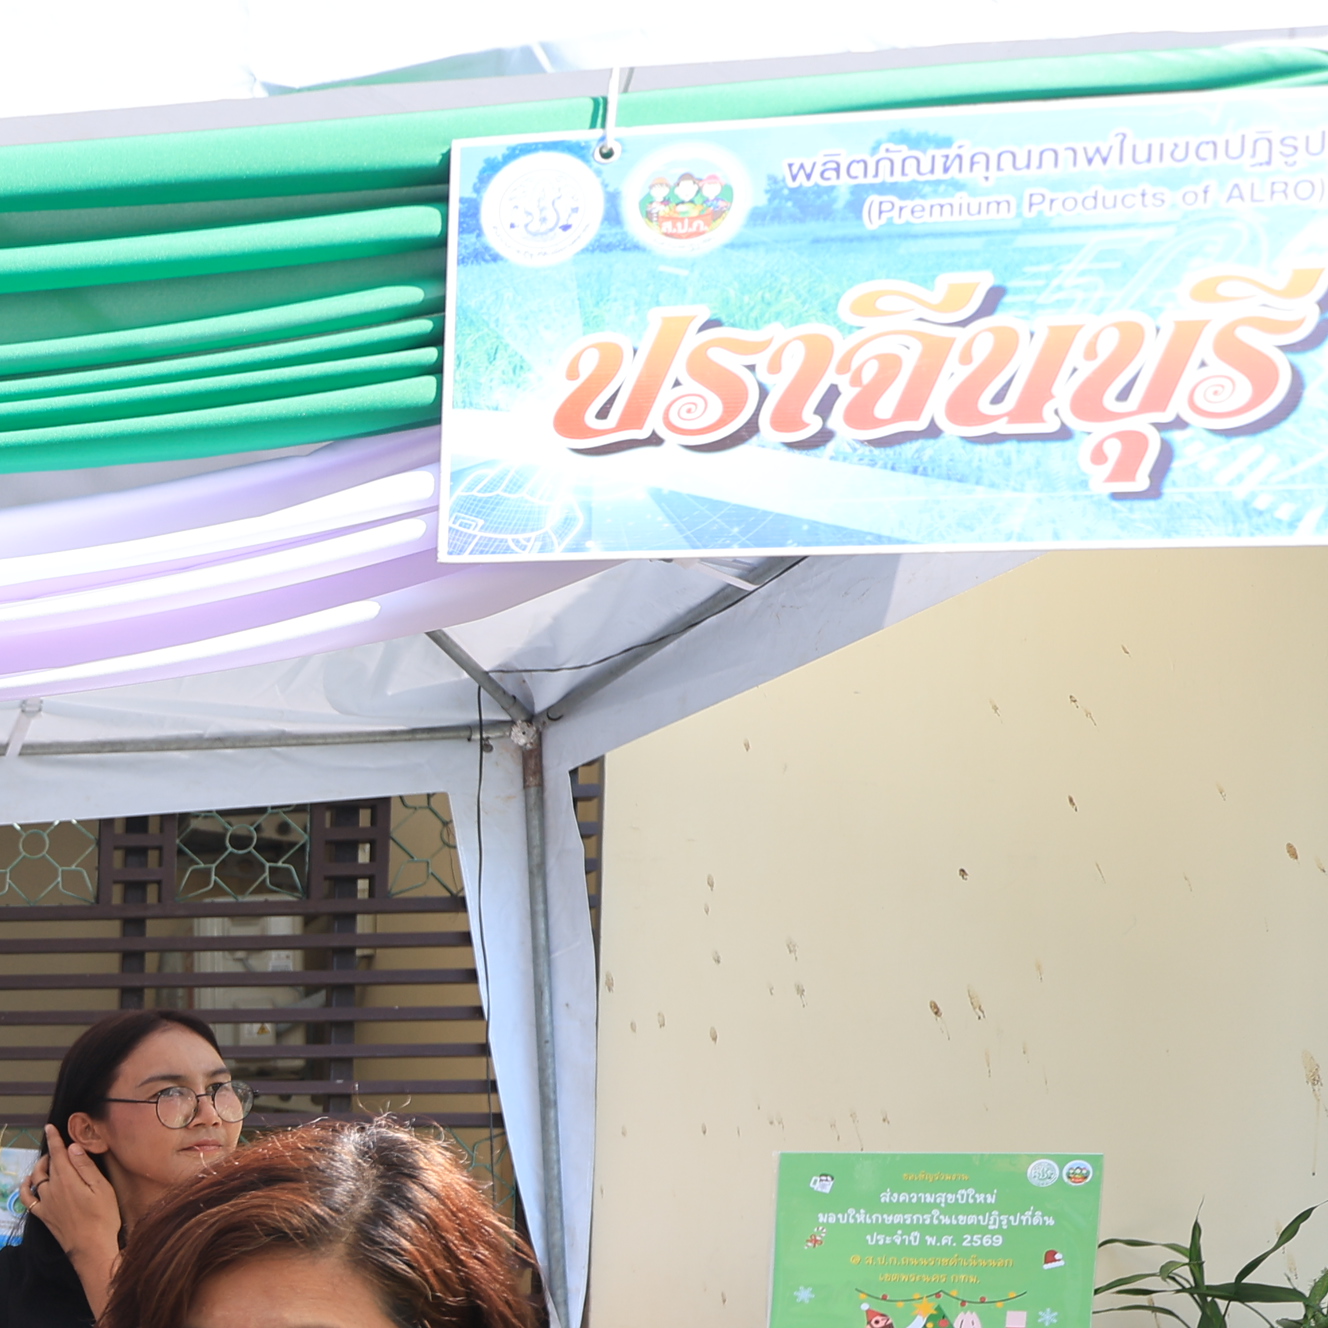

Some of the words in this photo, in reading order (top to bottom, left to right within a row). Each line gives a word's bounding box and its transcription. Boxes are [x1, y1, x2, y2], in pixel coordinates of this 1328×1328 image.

[865, 196, 1012, 227] (Premium
[1028, 186, 1166, 213] Products
[1182, 184, 1211, 206] of
[1225, 178, 1326, 204] ALRO)
[551, 267, 1328, 486] ปราจีนบุรี
[879, 1189, 998, 1207] ส่งความสุขปีใหม่
[866, 1230, 920, 1247] ประจำปี
[925, 1234, 957, 1247] พ.ศ.
[962, 1233, 1004, 1247] 2569
